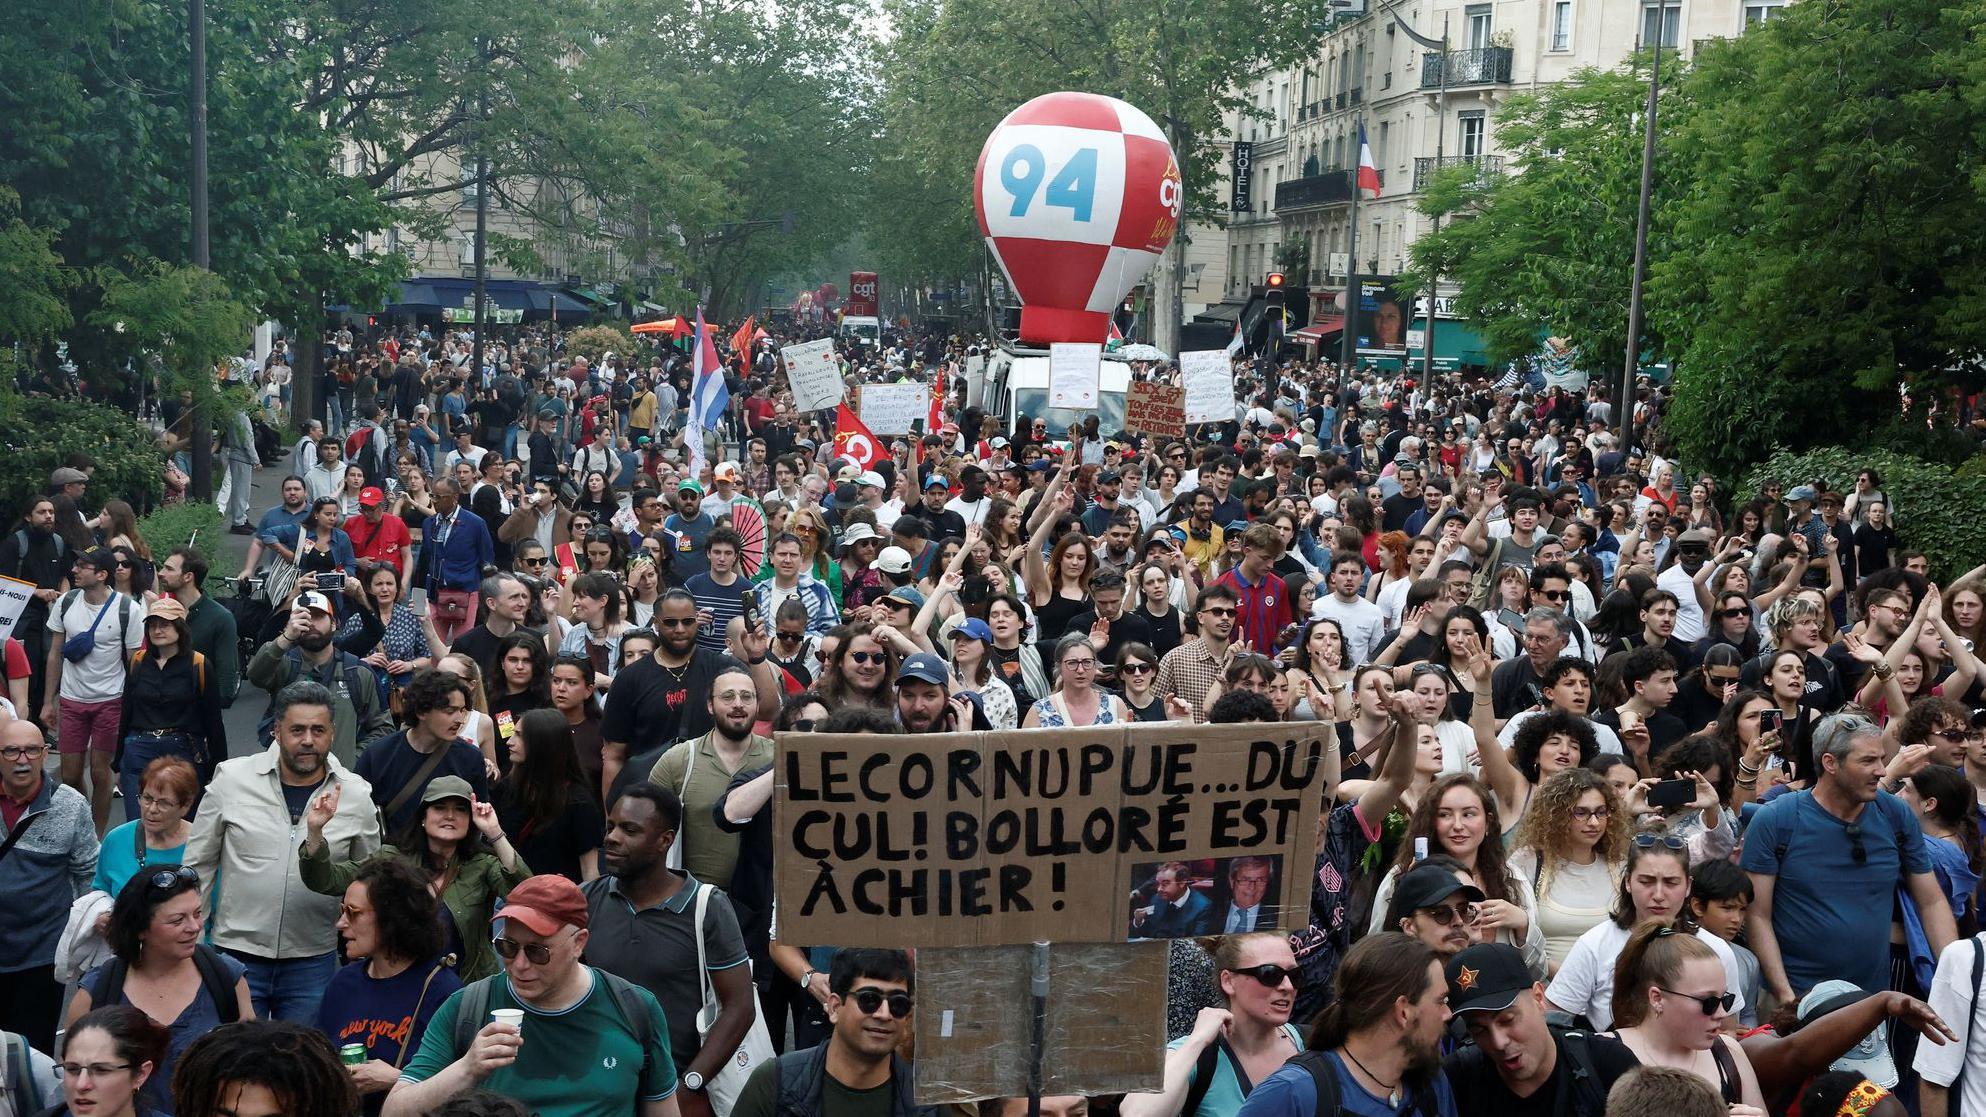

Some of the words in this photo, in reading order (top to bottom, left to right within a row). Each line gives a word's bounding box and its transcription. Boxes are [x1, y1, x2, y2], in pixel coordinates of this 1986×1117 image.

[1000, 144, 1098, 223] 94
[1237, 148, 1249, 195] HOTEL
[853, 282, 875, 297] cgt
[945, 796, 1187, 861] BOLLORÉ
[1209, 797, 1301, 848] EST
[340, 1019, 368, 1040] new
